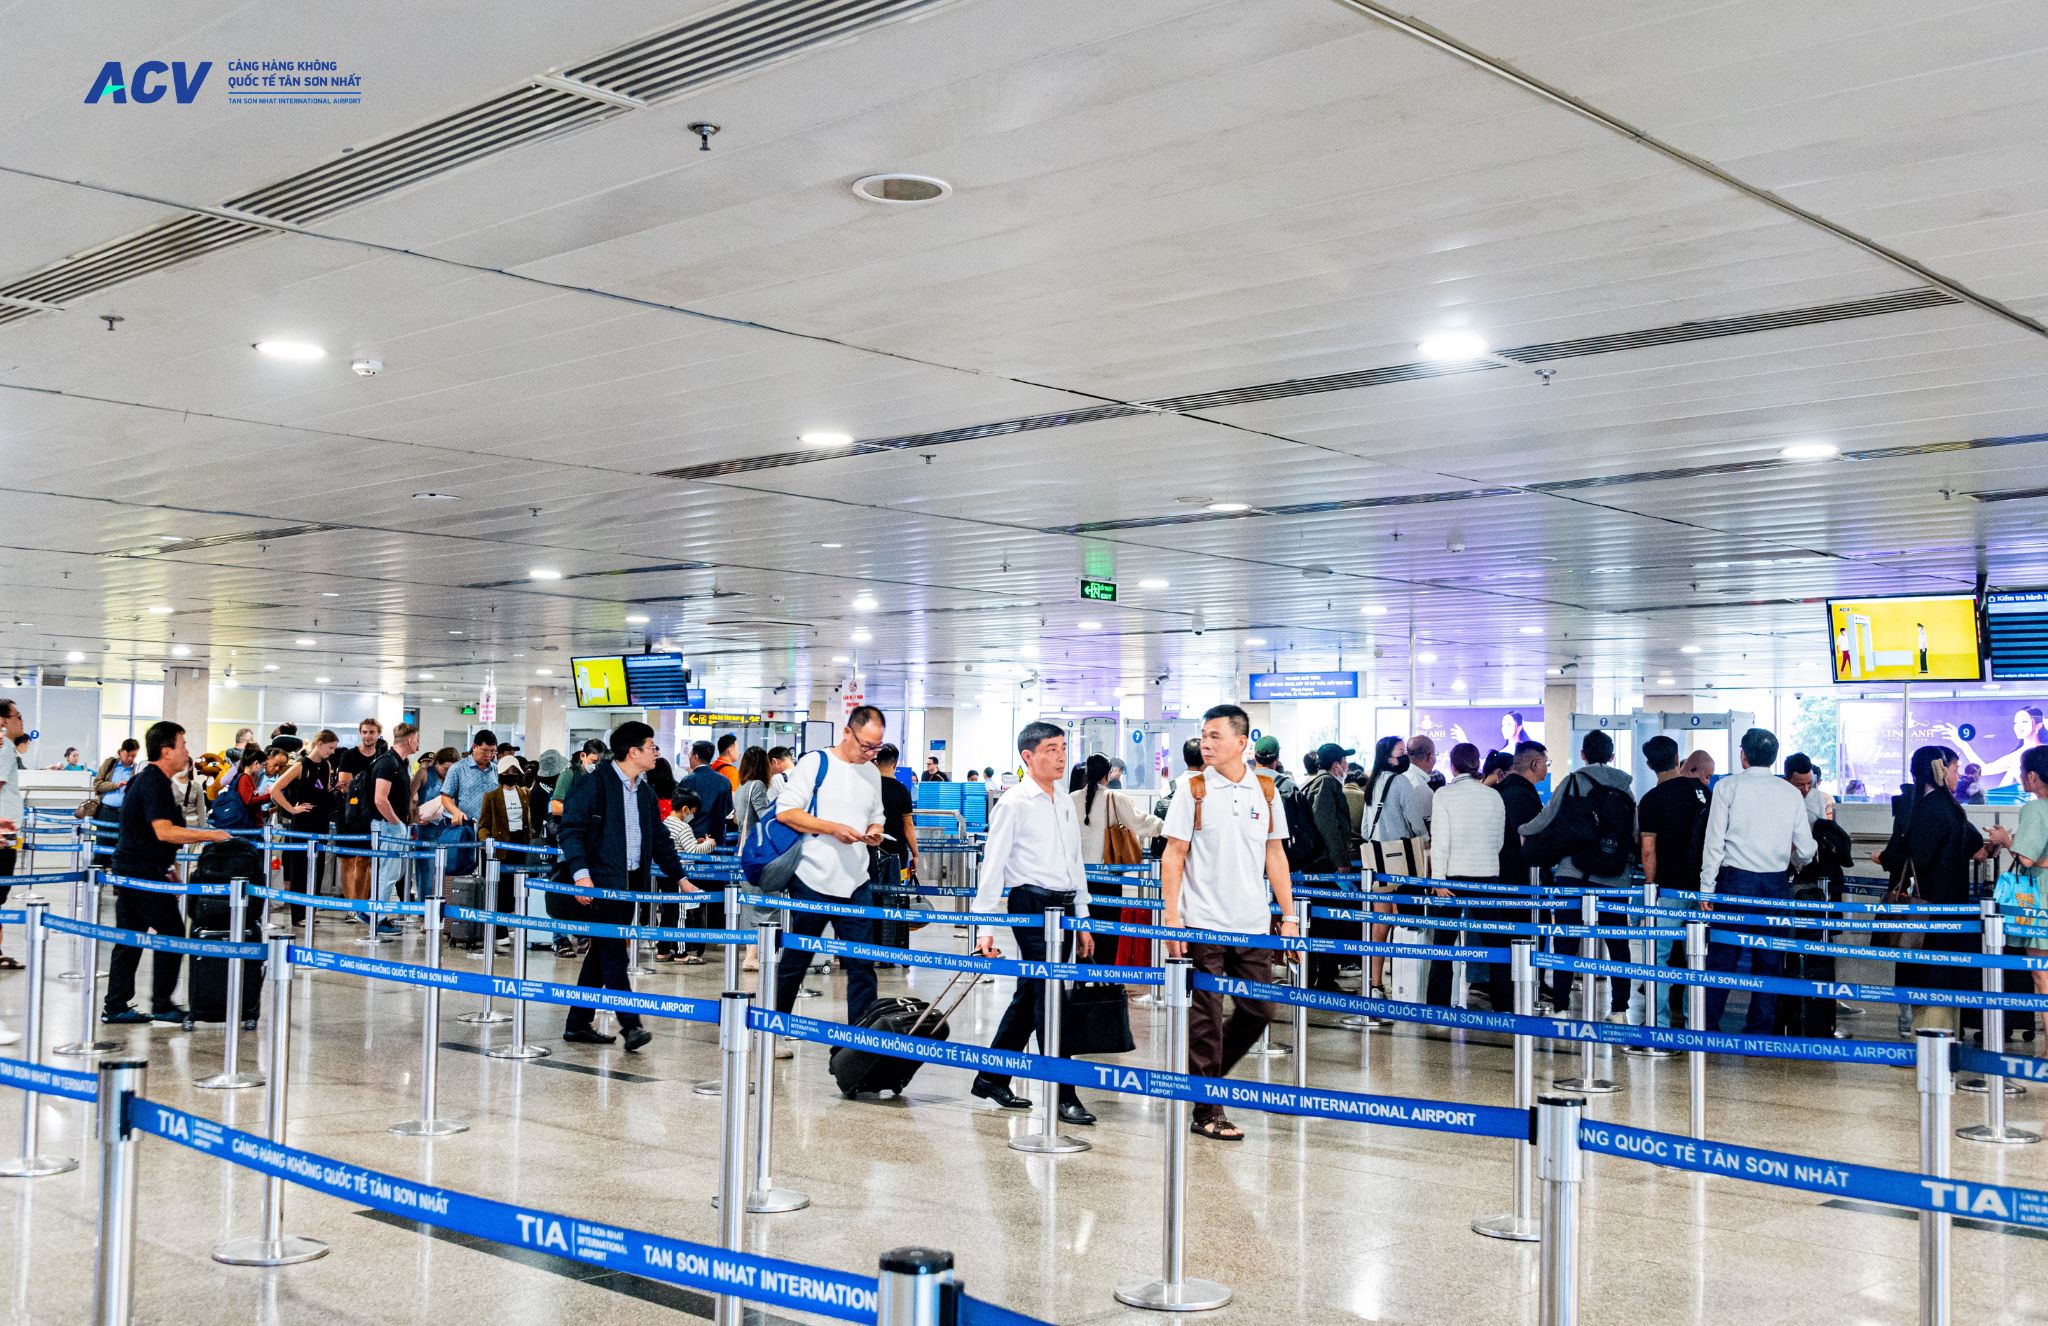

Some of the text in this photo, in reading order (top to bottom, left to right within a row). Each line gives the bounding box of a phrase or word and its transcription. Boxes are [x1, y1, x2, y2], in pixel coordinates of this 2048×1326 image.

[1997, 594, 2014, 602] Kiểm
[1135, 732, 1141, 741] 7
[1253, 731, 1259, 740] 8
[1911, 730, 1934, 738] ANH
[1963, 728, 1970, 738] 9
[1412, 896, 1431, 905] TIA
[883, 909, 902, 918] TIA
[1328, 909, 1351, 919] TIA
[1068, 919, 1091, 929] TIA
[1766, 917, 1791, 925] TIA
[618, 927, 638, 937] TIA
[1538, 926, 1564, 935] TIA
[799, 938, 823, 950] TIA
[1280, 938, 1308, 950] TIA
[1738, 935, 1767, 946] TIA
[295, 949, 314, 964] TIA
[1396, 947, 1453, 956] INTERNATIONAL
[1455, 950, 1488, 958] AIRPORT
[1018, 963, 1049, 976] TIA
[1088, 969, 1105, 977] TAN
[1122, 971, 1143, 979] NHAT
[493, 979, 517, 994] TIA
[1215, 978, 1249, 995] TIA
[1812, 983, 1853, 996] TIA
[552, 988, 694, 1013] TAN SON NHAT INTERNATIONAL AIRPORT
[1907, 992, 2048, 1007] TAN SON NHAT INTERNATIO
[750, 1010, 784, 1031] TIA
[1553, 1022, 1597, 1039] TIA
[828, 1026, 1032, 1071] CẢNG HÀNG KHÔNG QUỐC TẾ TÂN SƠN NHẤT
[1650, 1032, 1916, 1060] TAN SON NHAT INTERNATIONAL AIRPORT
[1094, 1067, 1142, 1090] TIA
[1205, 1084, 1476, 1126] TAN SON NHAT INTERNATIONAL AIRPORT
[158, 1110, 188, 1139] TIA
[1922, 1181, 2009, 1217] TIA
[516, 1214, 568, 1250] TIA
[643, 1245, 878, 1313] TAN SON NHAT INTERNATION
